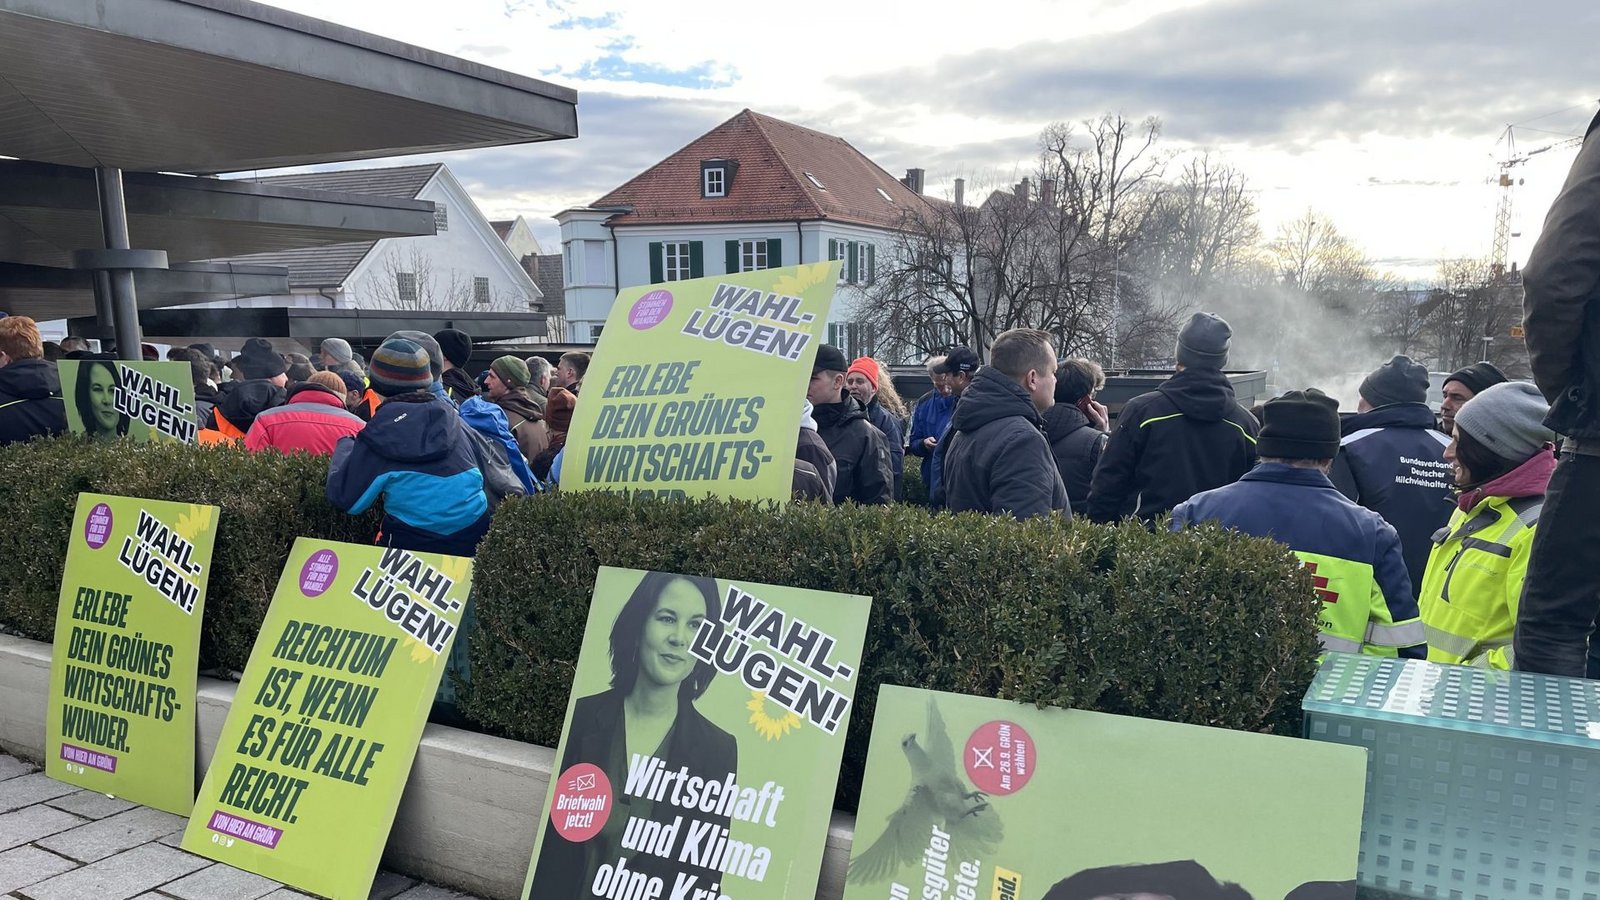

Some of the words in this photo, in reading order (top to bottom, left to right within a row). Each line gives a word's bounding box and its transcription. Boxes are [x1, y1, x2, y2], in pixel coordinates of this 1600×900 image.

[648, 292, 664, 300] ALLE
[711, 284, 815, 325] WAHL-
[682, 310, 811, 360] LÜGEN!
[121, 365, 192, 414] WAHL-
[602, 360, 702, 399] ERLEBE
[114, 388, 197, 444] LÜGEN!
[591, 401, 658, 440] DEIN
[654, 393, 766, 438] GRÜNES
[583, 440, 772, 483] WIRTSCHAFTS-
[1395, 475, 1448, 489] Milchviehhalter
[1411, 467, 1445, 478] Deutscher
[136, 510, 202, 576] WAHL-
[317, 554, 332, 563] ALLE
[119, 537, 199, 614] LÜGEN!
[378, 547, 461, 612] WAHL-
[72, 586, 133, 629] ERLEBE
[352, 568, 454, 653] LÜGEN!
[67, 625, 108, 666] DEIN
[106, 631, 174, 680] GRÜNES
[272, 620, 398, 678] REICHTUM
[723, 588, 852, 678] WAHL-
[63, 664, 182, 722] WIRTSCHAFTS-
[254, 666, 303, 716] IST,
[298, 674, 379, 728] WENN
[691, 621, 849, 733] LÜGEN!
[61, 703, 131, 754] WUNDER.
[236, 714, 276, 758] ES
[266, 717, 322, 770] FÜR
[312, 733, 384, 786] ALLE
[998, 724, 1011, 749] GRÜN
[999, 750, 1011, 773] 26.9.
[1013, 739, 1025, 775] wählen!
[218, 762, 309, 824] REICHT.
[557, 793, 607, 811] Briefwahl
[624, 753, 785, 828] Wirtschaft
[1000, 774, 1011, 790] Am
[213, 813, 230, 831] VON
[226, 818, 246, 836] HIER
[241, 823, 257, 839] AN
[563, 811, 594, 830] jetzt!
[621, 816, 683, 859] und
[678, 819, 772, 882] Klima
[922, 824, 951, 900] sgüter
[591, 857, 664, 900] ohne
